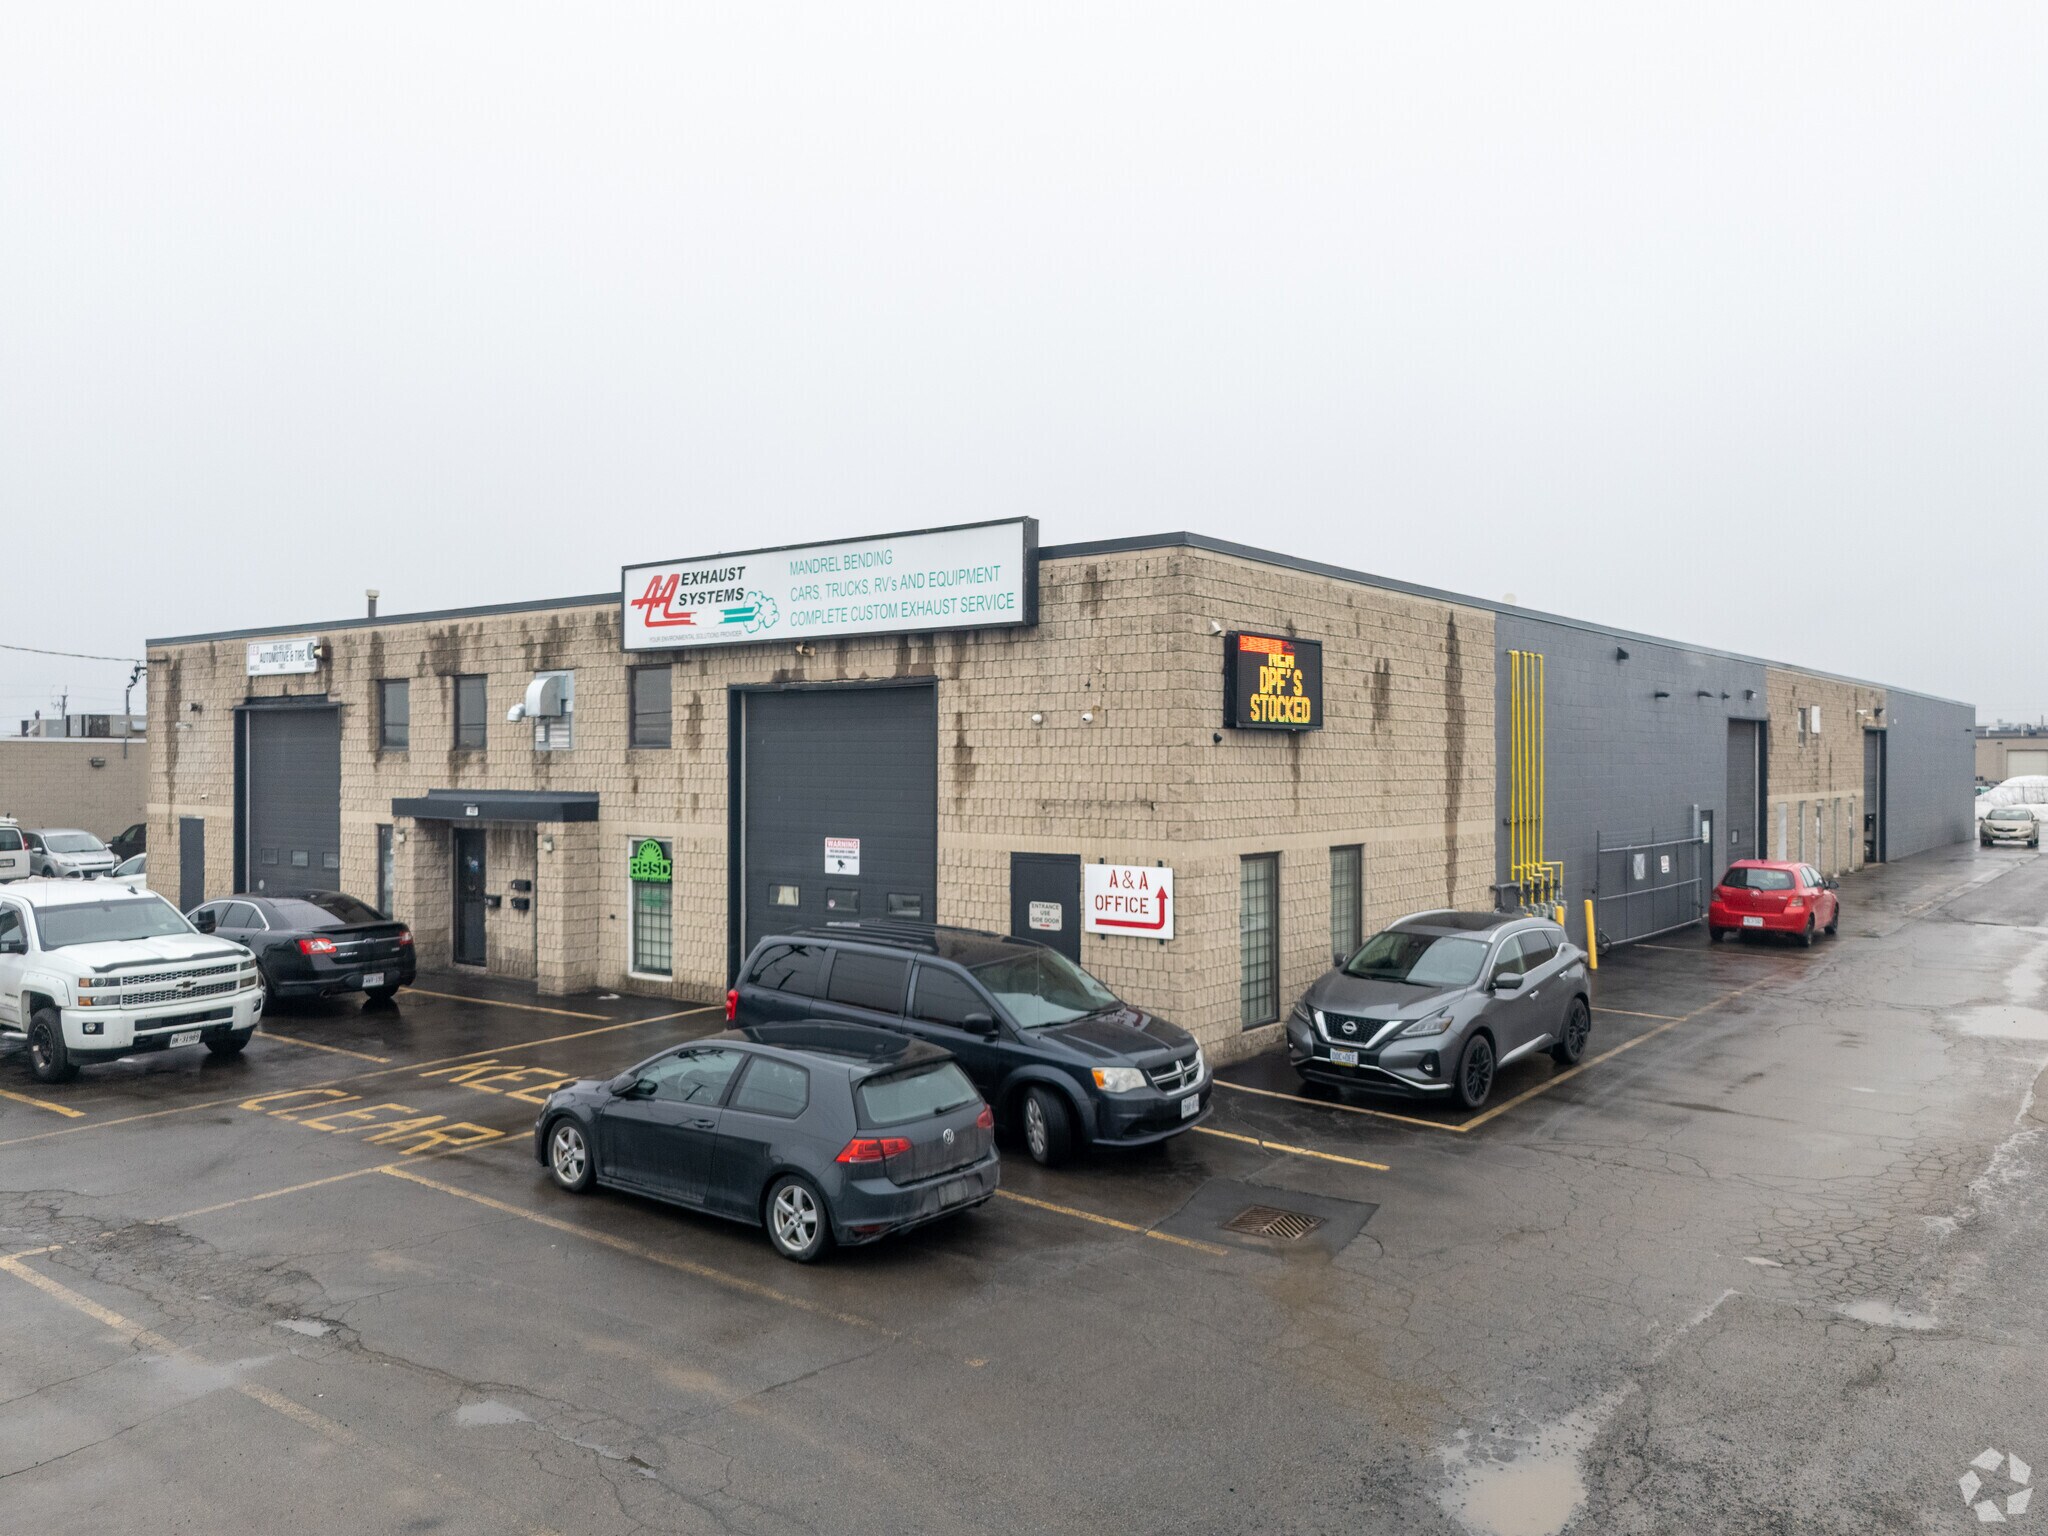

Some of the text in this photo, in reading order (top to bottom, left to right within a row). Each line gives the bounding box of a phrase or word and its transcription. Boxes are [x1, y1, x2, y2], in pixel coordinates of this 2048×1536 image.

[789, 549, 893, 576] MANDREL BENDING
[681, 566, 746, 586] EXHAUST
[790, 565, 1001, 602] CARS, TRUCKS, RV's AND EQUIPMENT
[678, 587, 744, 606] SYSTEMS
[790, 592, 1015, 627] COMPLETE CUSTOM EXHAUST SERVICE
[260, 651, 289, 664] AUTOMOTIVE
[1259, 665, 1303, 696] DPF'S
[1250, 693, 1311, 724] STOCKED
[631, 860, 671, 877] RBSD
[1109, 869, 1149, 891] A & A
[1095, 894, 1149, 915] OFFICE
[1044, 917, 1060, 925] DOOR
[238, 1088, 507, 1156] CLEAR
